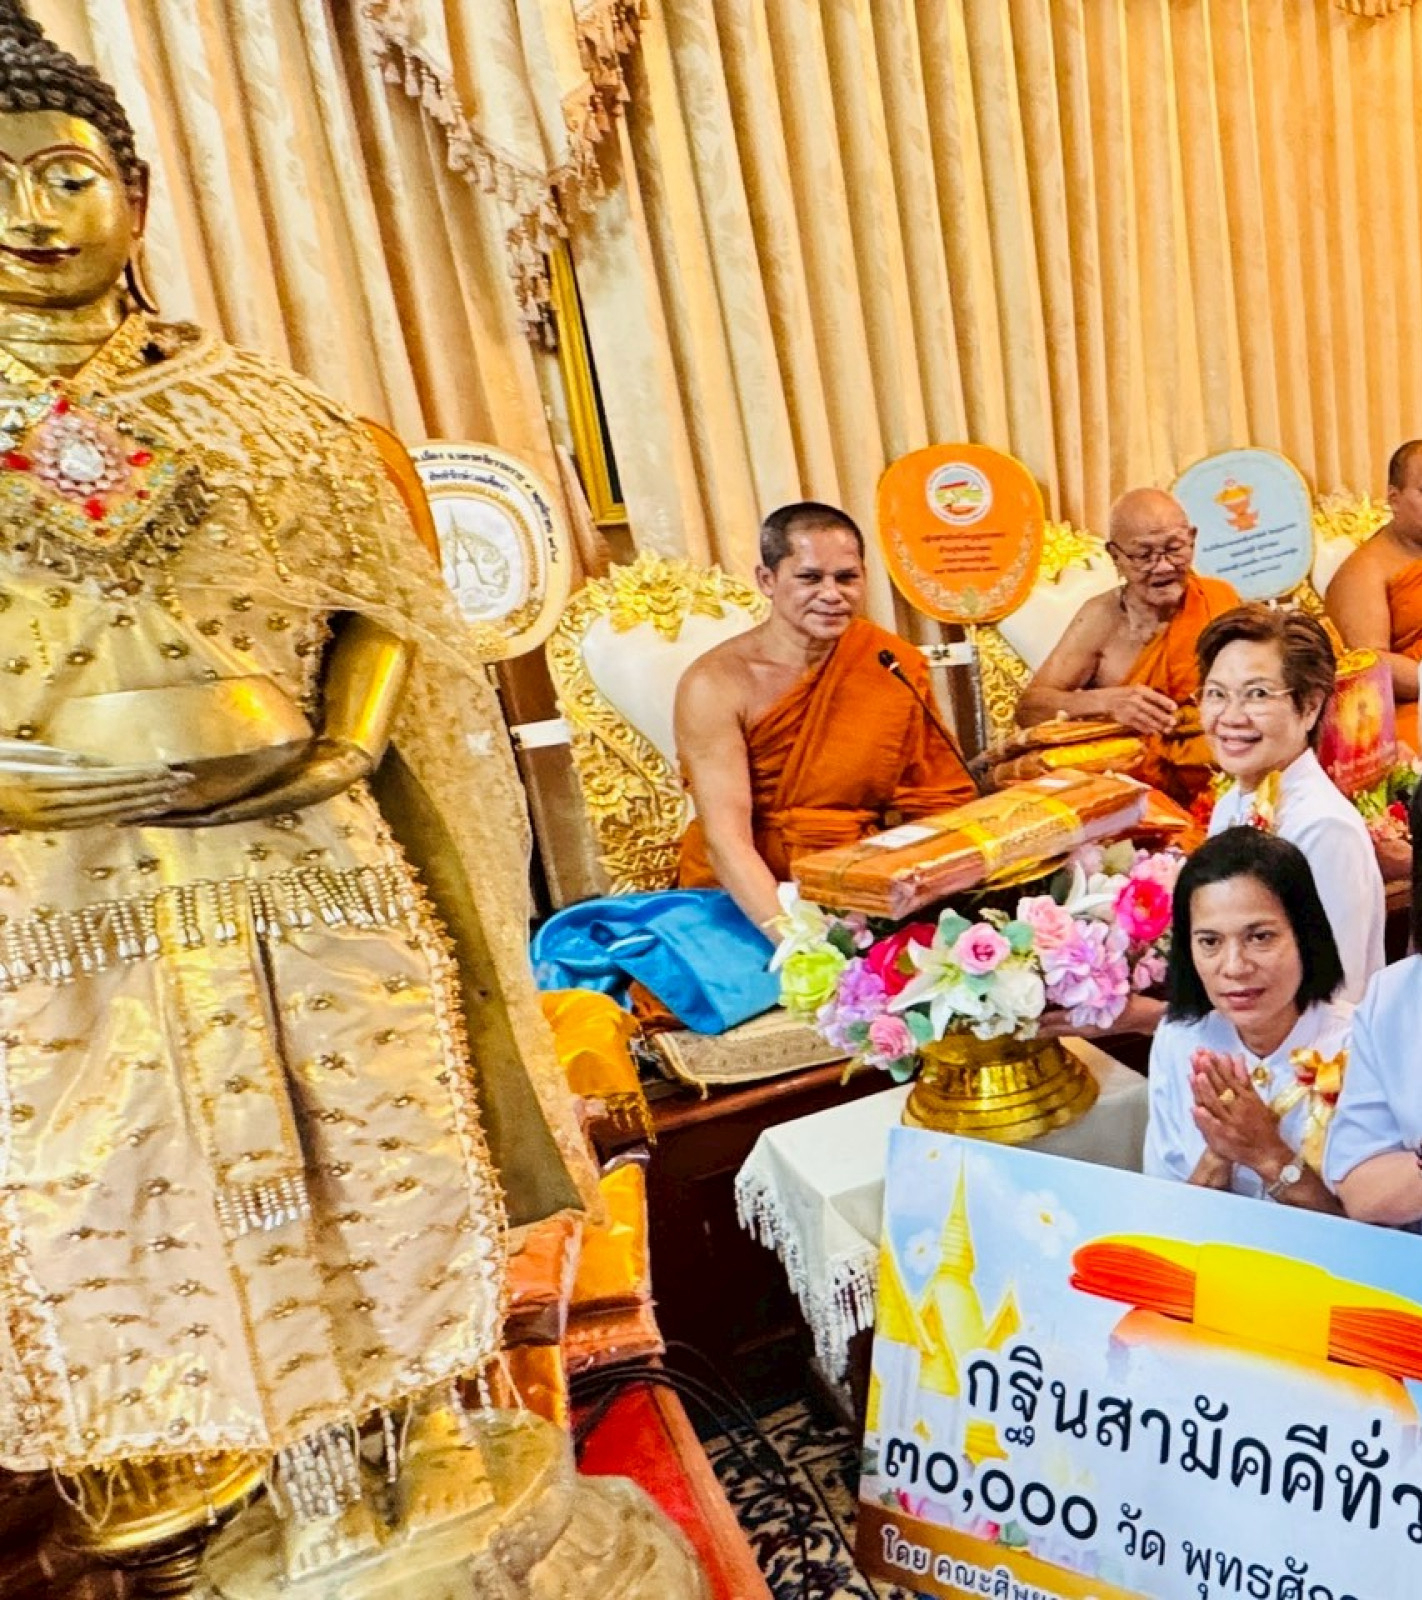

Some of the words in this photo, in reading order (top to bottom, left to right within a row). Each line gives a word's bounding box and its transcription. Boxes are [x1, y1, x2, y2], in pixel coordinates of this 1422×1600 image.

[883, 1527, 928, 1571] โดย
[885, 1437, 1098, 1541] ๓๐,๐๐๐
[1117, 1502, 1166, 1566] วัด
[1182, 1540, 1358, 1600] พุทธศั
